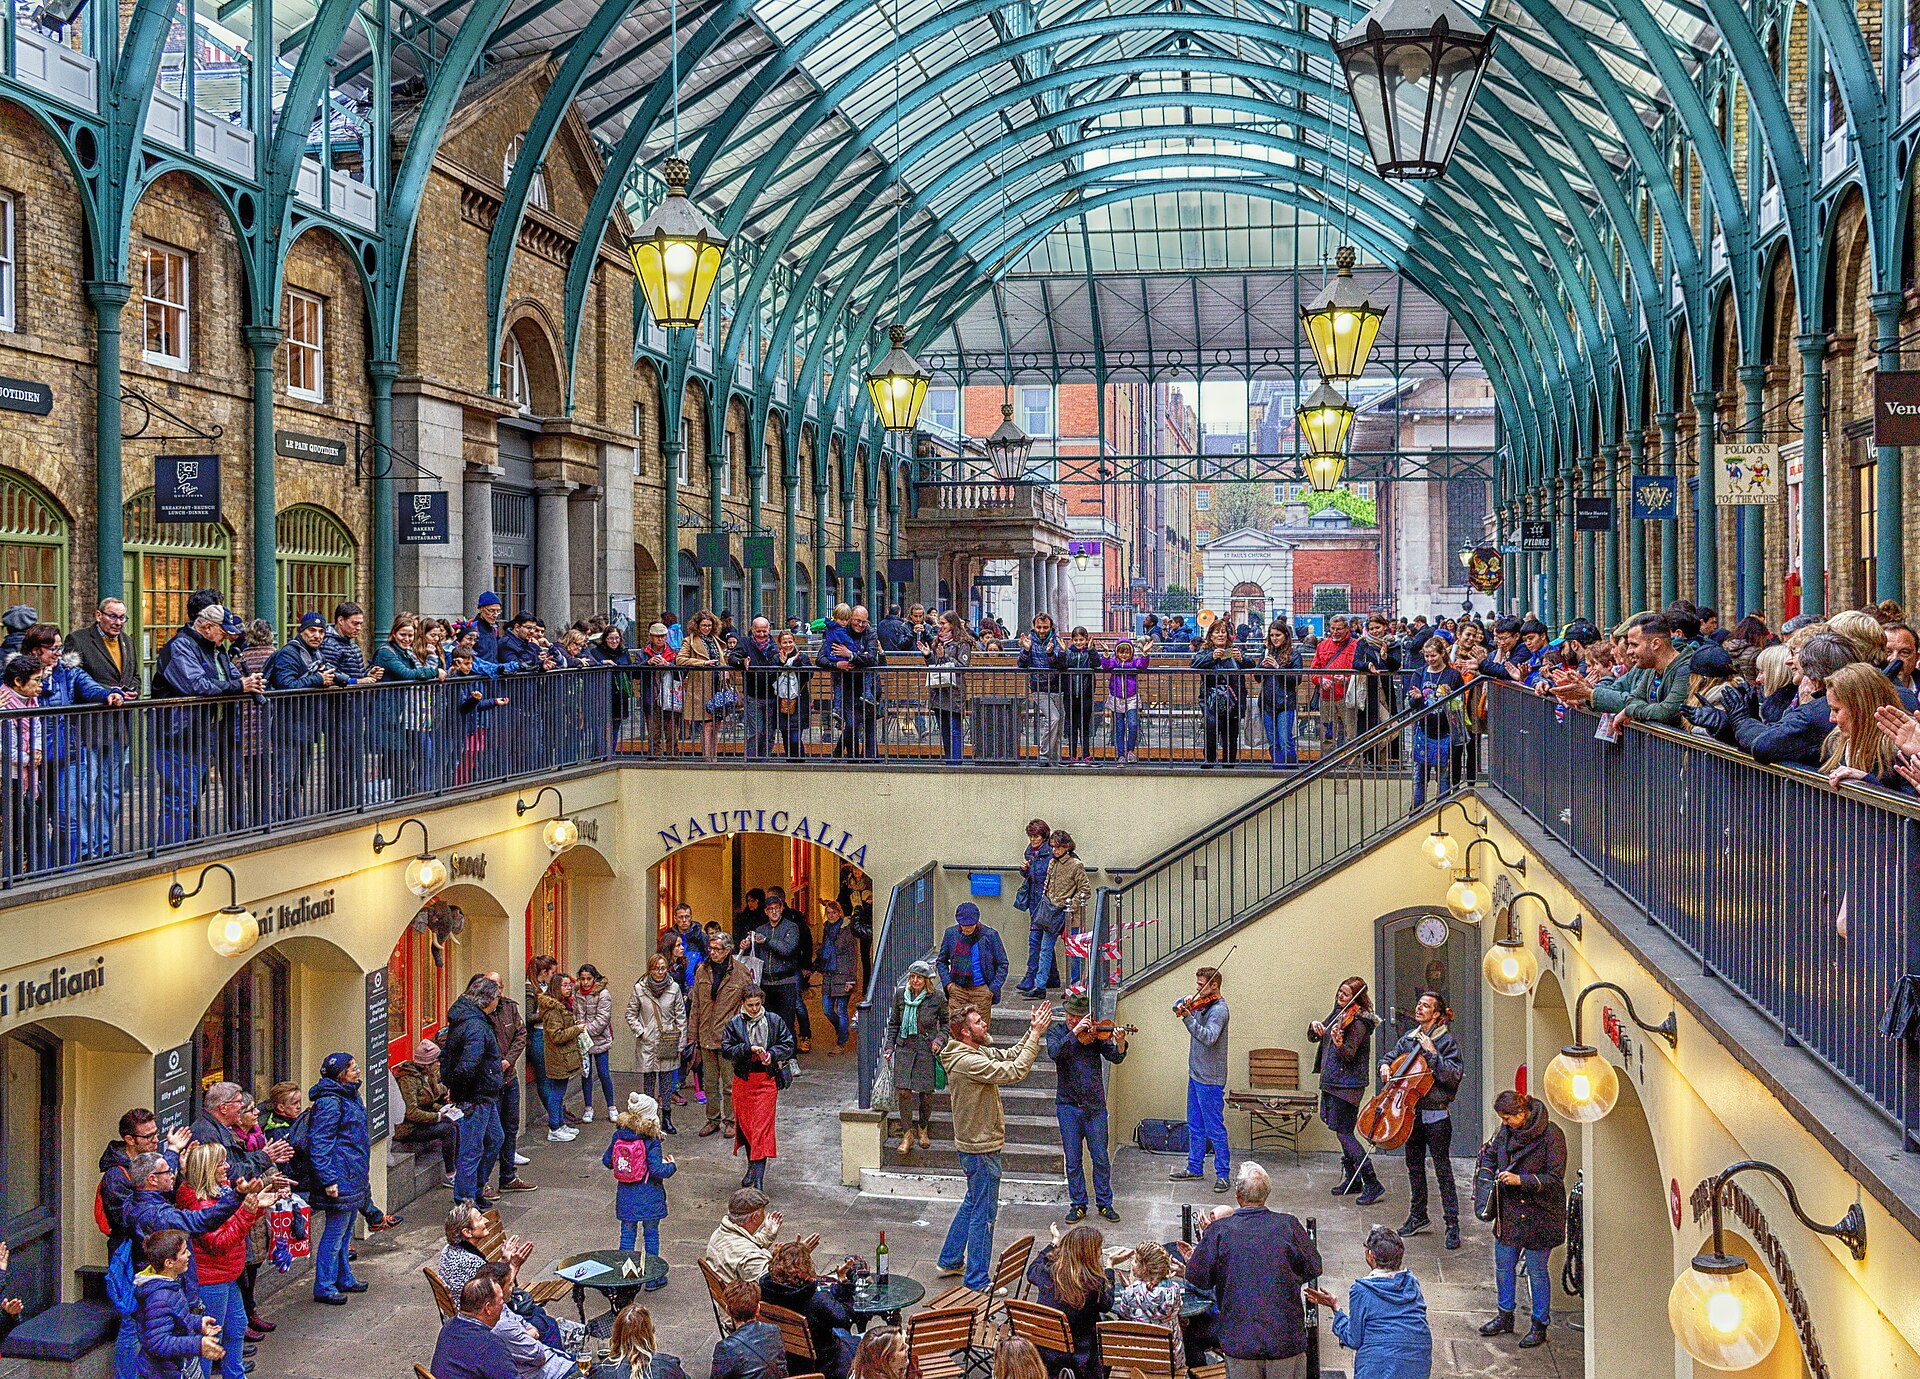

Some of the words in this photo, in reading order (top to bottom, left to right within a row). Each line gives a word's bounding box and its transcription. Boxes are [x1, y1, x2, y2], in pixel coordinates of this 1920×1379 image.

[1885, 401, 1920, 416] Ven
[285, 440, 294, 448] LE
[294, 441, 308, 450] PAIN
[309, 444, 339, 456] QUOTIDIEN
[1737, 494, 1779, 504] THEATRES
[658, 809, 868, 868] NAUTICALIA
[279, 888, 335, 930] Italiani
[18, 956, 104, 1012] Italiani
